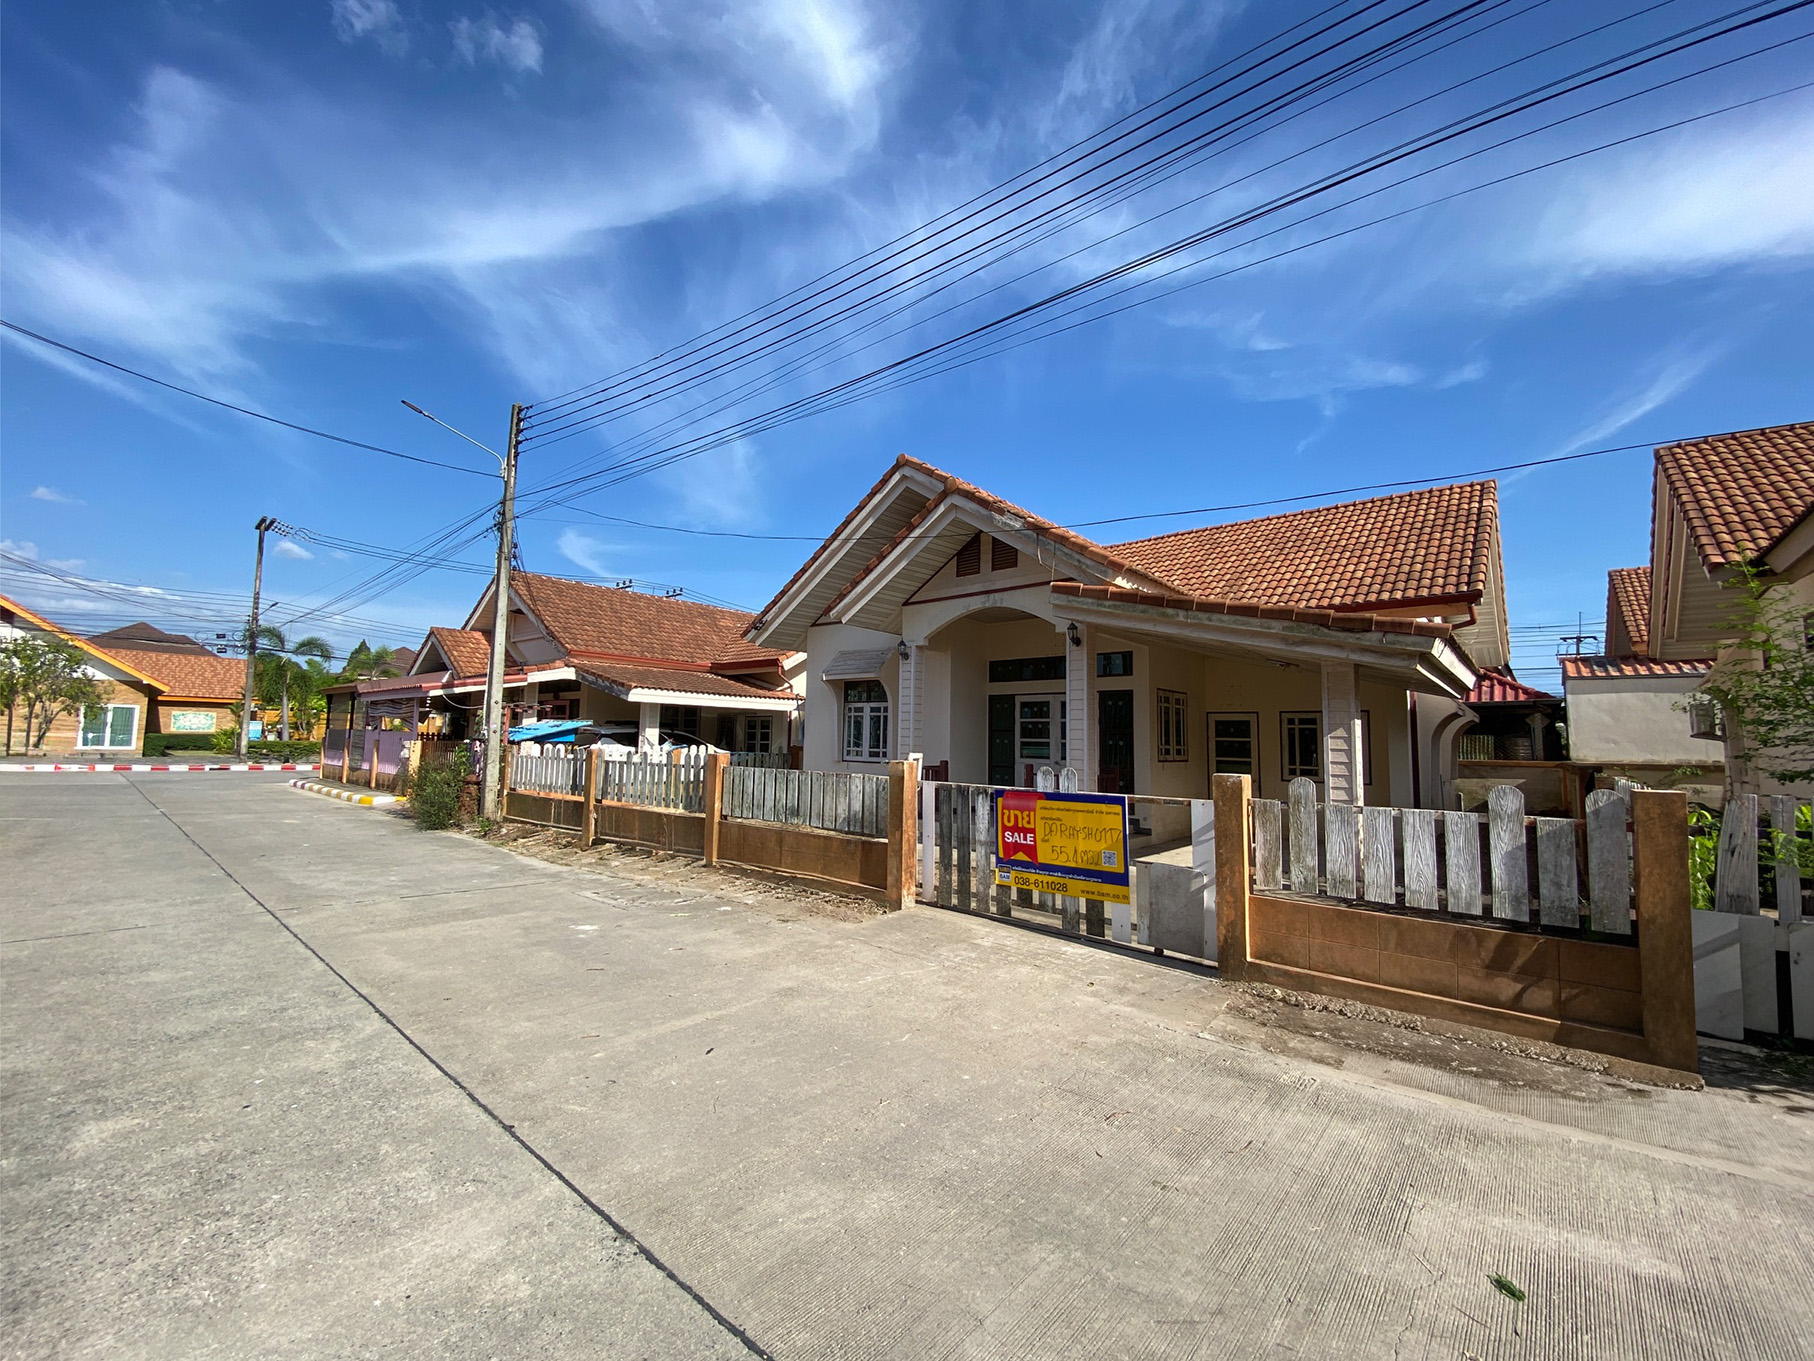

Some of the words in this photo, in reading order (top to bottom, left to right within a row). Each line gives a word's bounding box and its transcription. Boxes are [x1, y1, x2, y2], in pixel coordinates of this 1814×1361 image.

[1003, 809, 1035, 829] ขาย
[1004, 831, 1035, 845] SALE
[1014, 875, 1068, 893] 038-611028
[1080, 889, 1129, 900] www.bam.co.th
